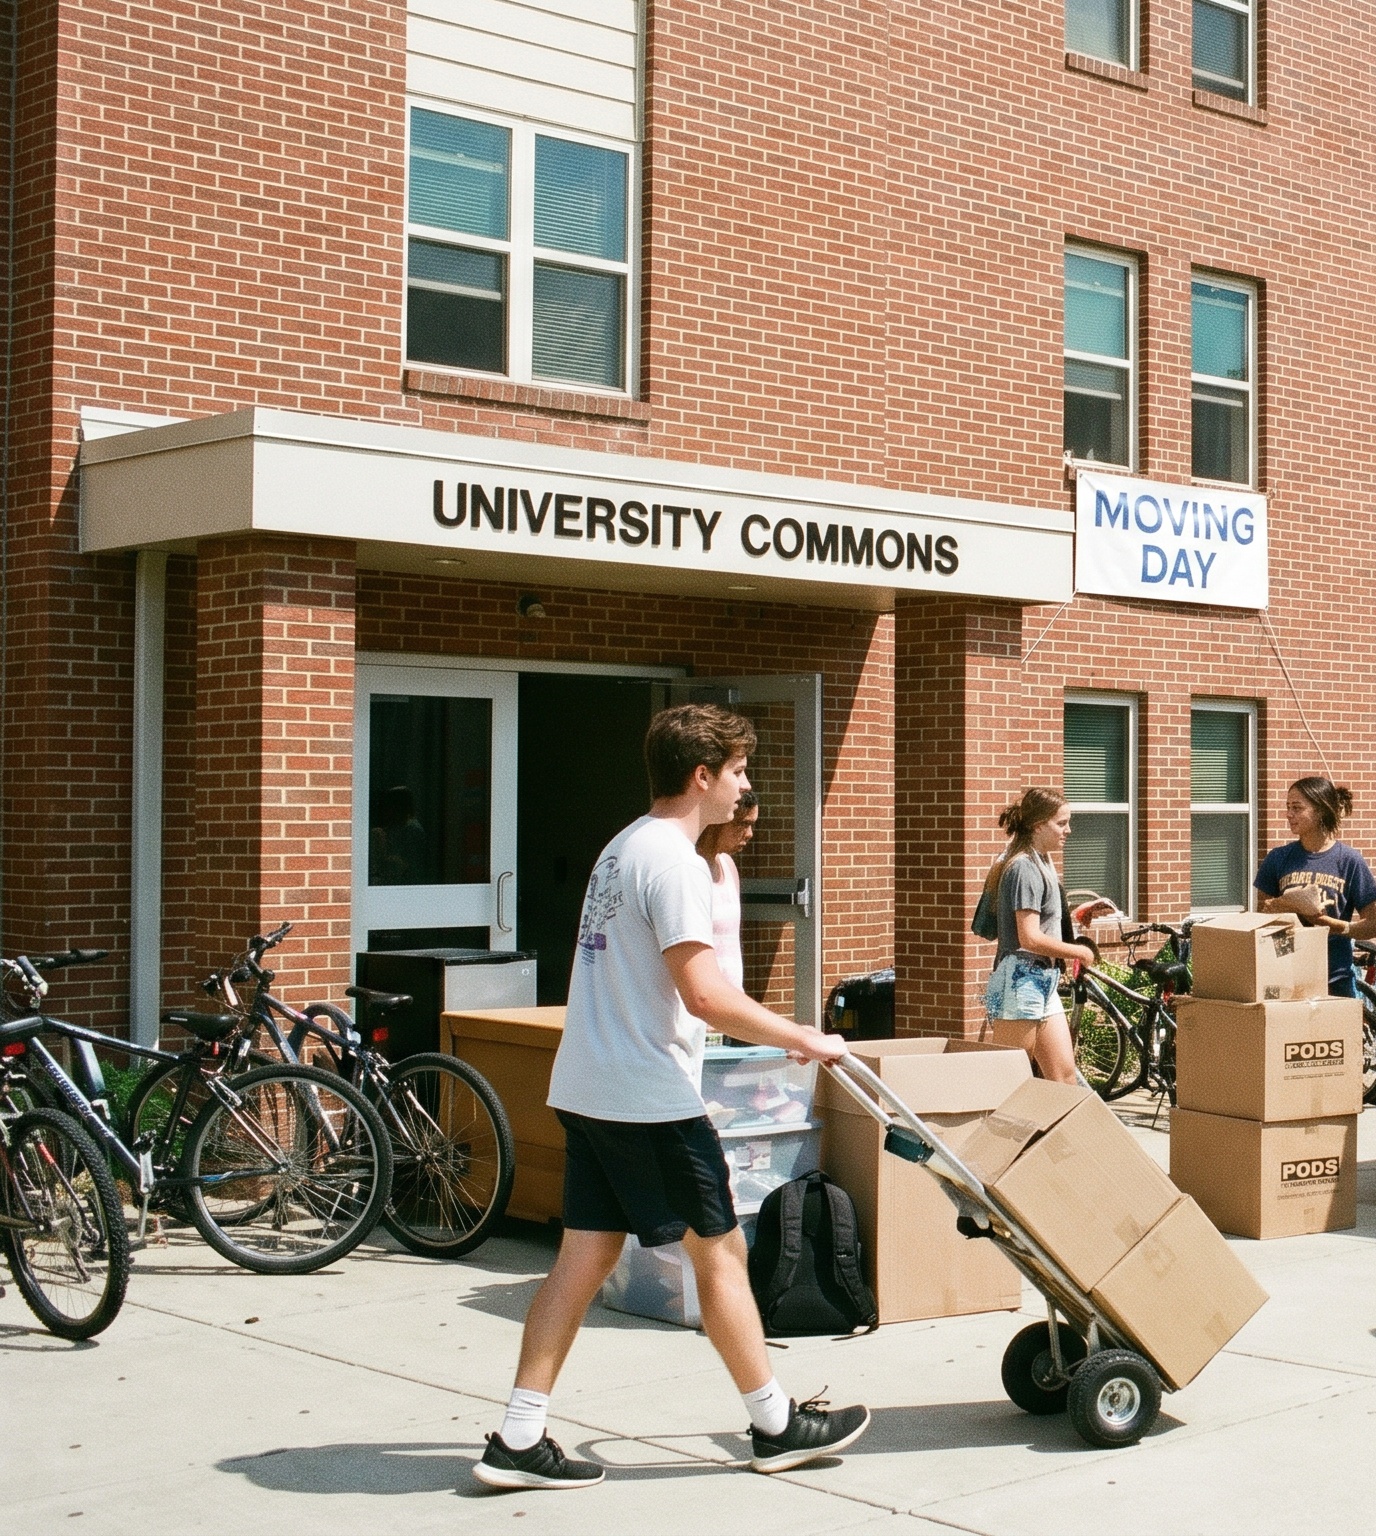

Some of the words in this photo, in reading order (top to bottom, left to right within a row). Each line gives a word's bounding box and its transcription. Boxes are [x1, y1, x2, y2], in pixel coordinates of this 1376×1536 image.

[433, 478, 722, 552] UNIVERSITY
[740, 513, 960, 575] COMMONS
[1094, 489, 1256, 546] MOVING
[1140, 544, 1217, 588] DAY
[1285, 1041, 1343, 1060] PODS
[1282, 1158, 1338, 1180] PODS
